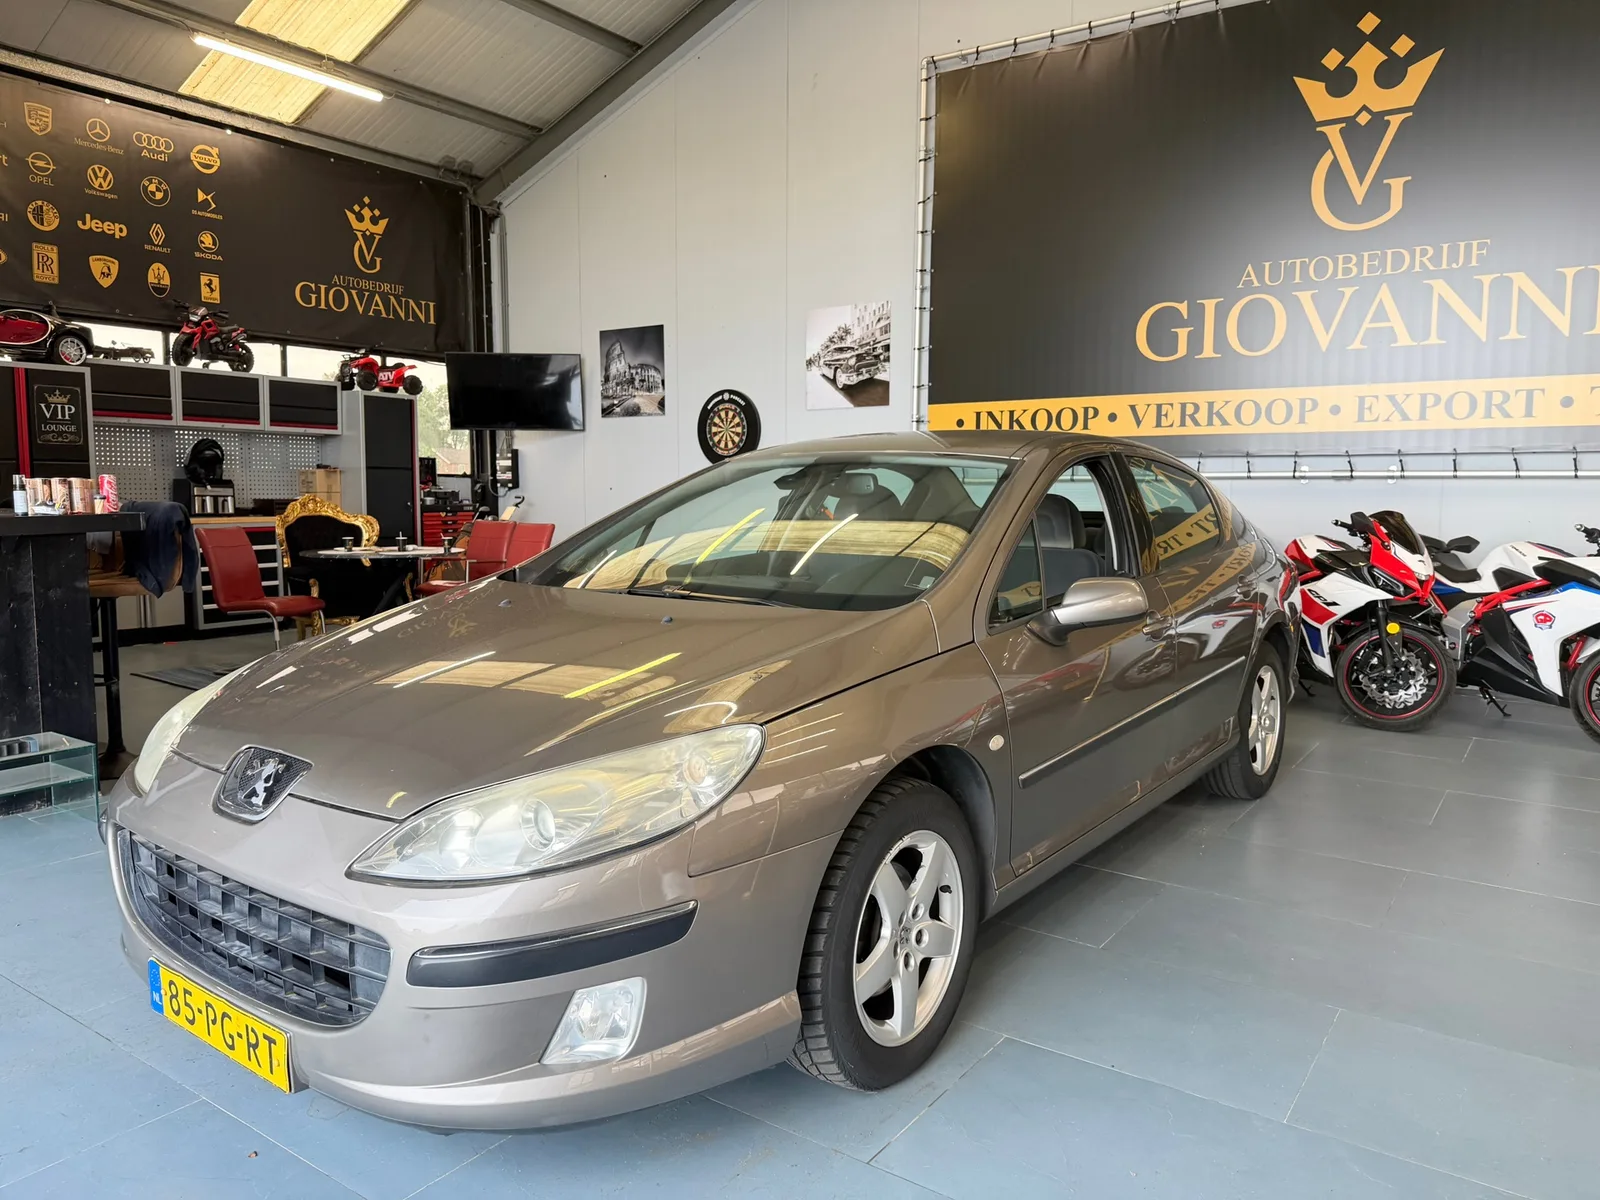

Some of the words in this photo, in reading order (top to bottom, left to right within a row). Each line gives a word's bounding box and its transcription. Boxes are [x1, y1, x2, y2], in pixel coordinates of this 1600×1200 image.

[141, 149, 168, 162] Audi
[193, 154, 218, 164] VOLVO
[29, 174, 54, 187] OPEL
[77, 213, 128, 239] Jeep
[144, 244, 171, 254] RENAULT
[1236, 239, 1491, 289] AUTOBEDRIJF
[332, 274, 404, 296] AUTOBEDRIJF
[295, 281, 437, 325] GIOVANNI
[39, 403, 76, 421] VIP
[973, 406, 1100, 432] INKOOP
[1128, 397, 1319, 429] VERKOOP
[1354, 387, 1546, 423] EXPORT
[41, 424, 77, 433] LOUNGE
[152, 991, 162, 1005] NL
[168, 979, 277, 1075] 85-PG-RT
